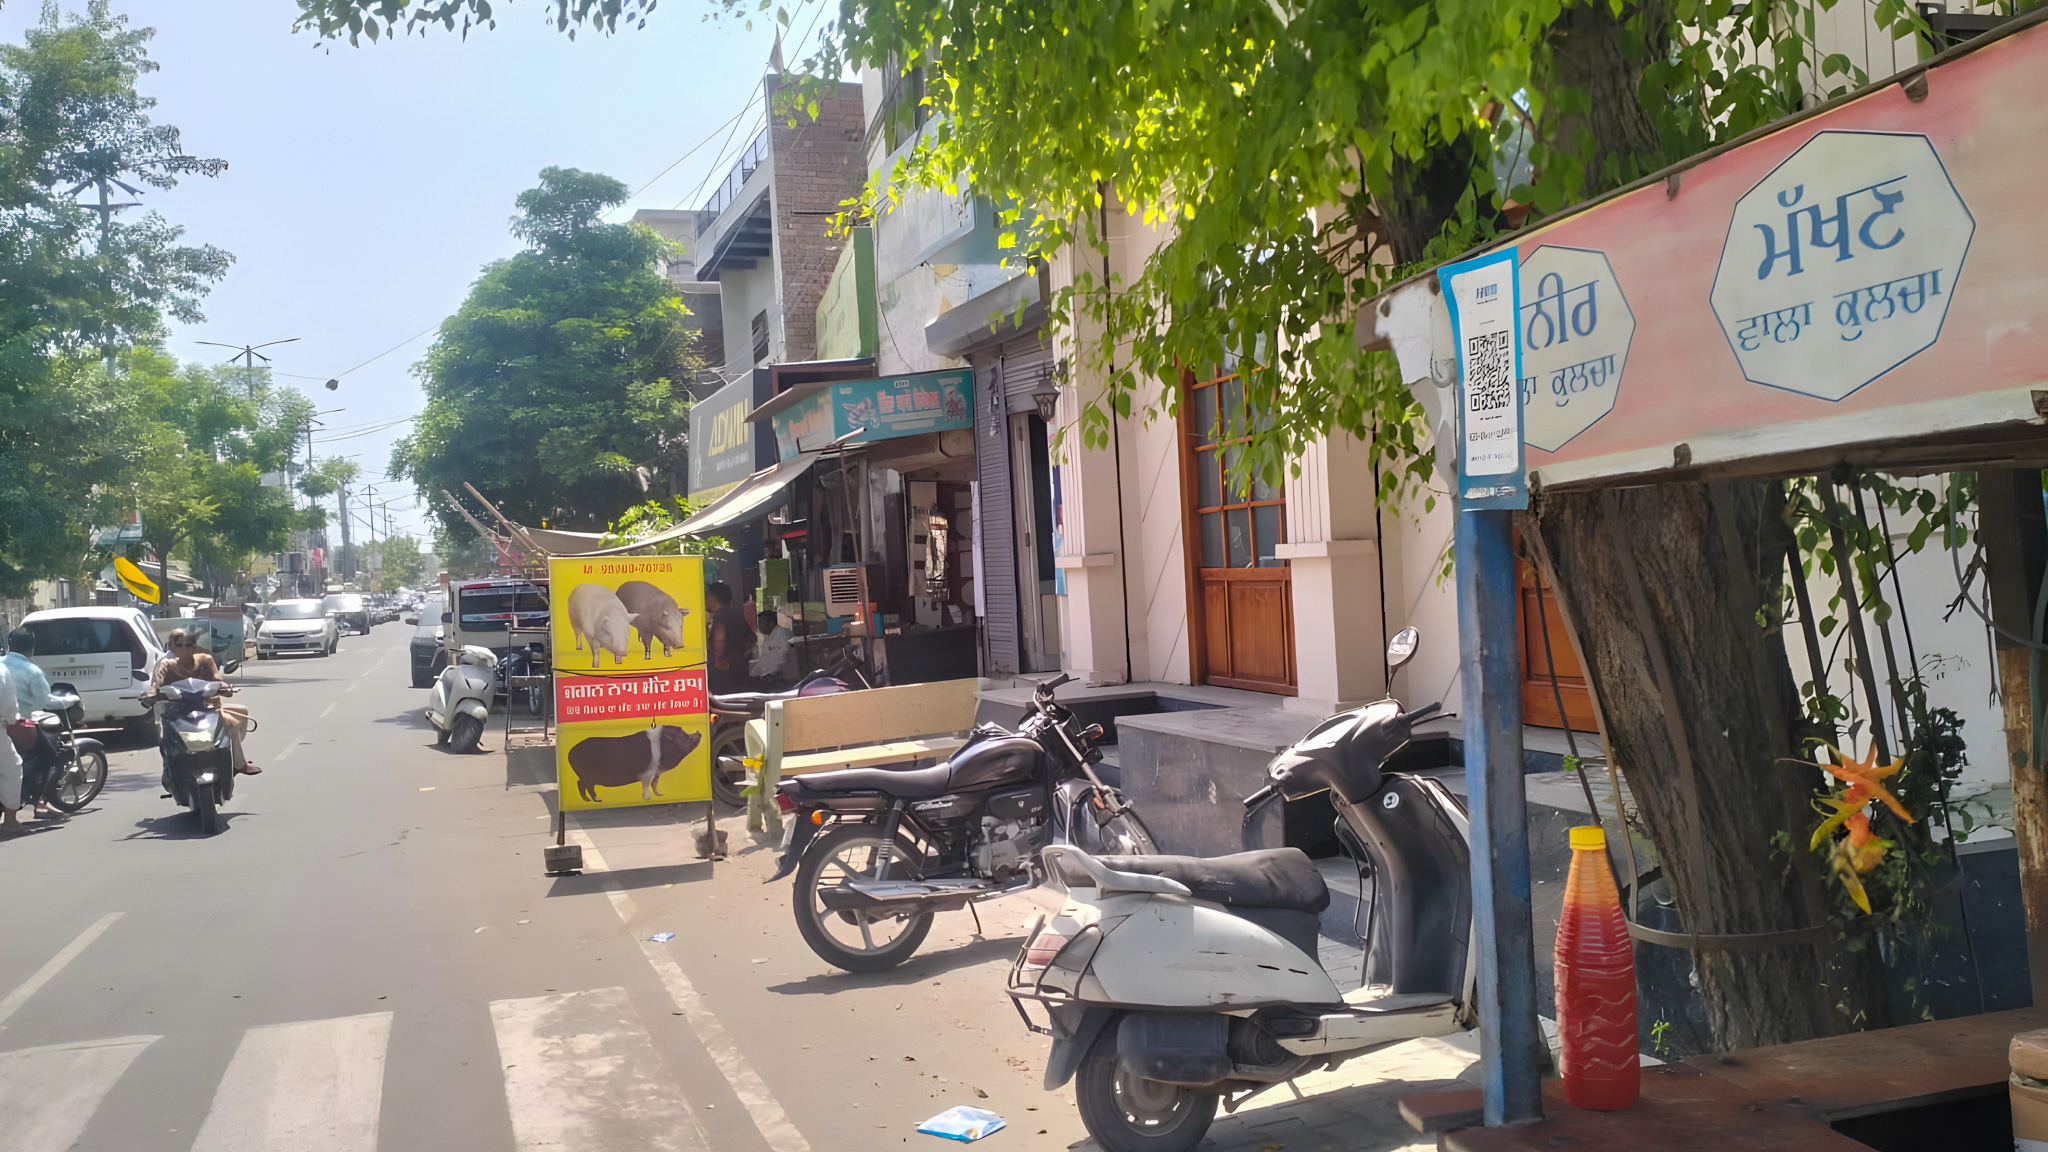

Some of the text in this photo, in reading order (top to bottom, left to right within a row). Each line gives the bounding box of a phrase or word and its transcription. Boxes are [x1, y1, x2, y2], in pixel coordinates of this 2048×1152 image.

[1753, 175, 1908, 280] ਮੱਖਣ
[1519, 272, 1600, 351] ਨੀਰ
[1736, 268, 1943, 351] ਵਾਲਾ ਕੁਲਚਾ
[1549, 353, 1617, 408] ਕੁਲਚਾ
